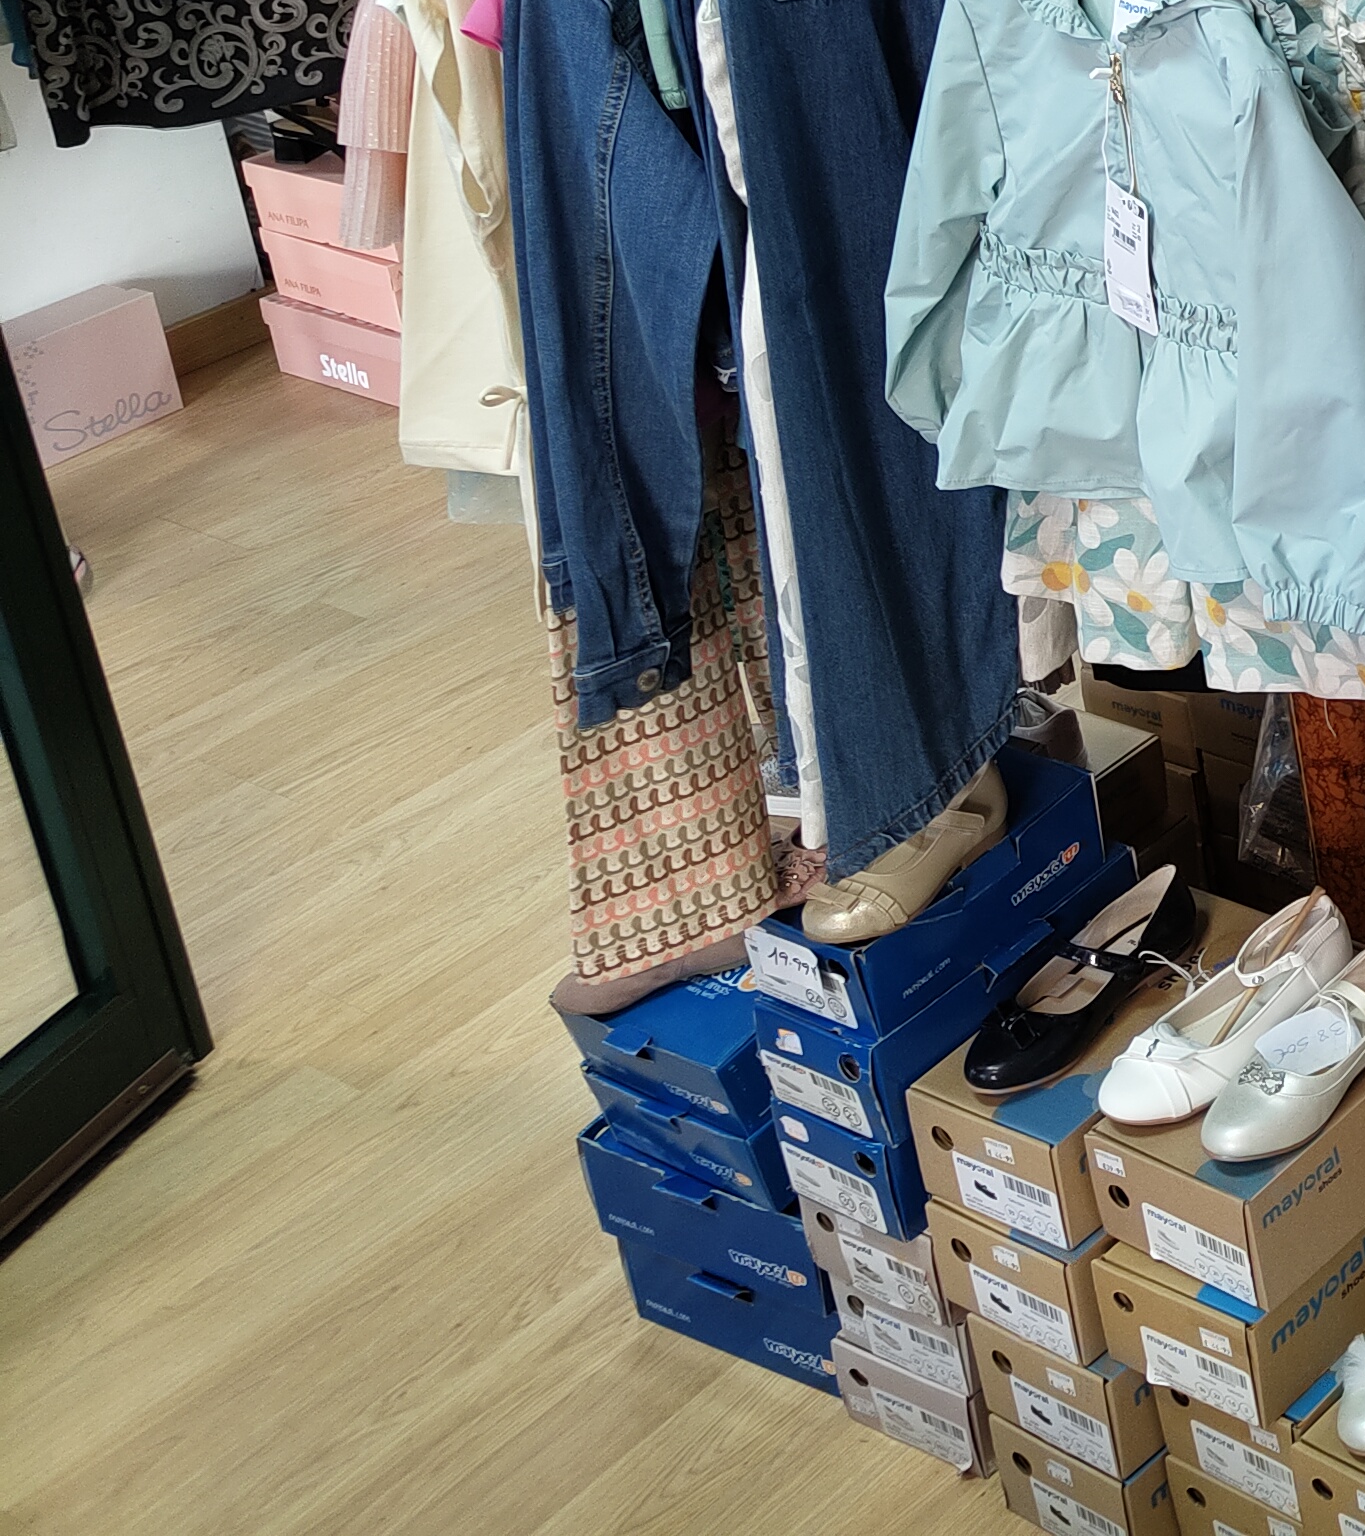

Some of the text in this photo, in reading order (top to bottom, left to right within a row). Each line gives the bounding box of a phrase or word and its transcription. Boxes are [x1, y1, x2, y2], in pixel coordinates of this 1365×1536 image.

[268, 211, 310, 230] ANA FILIPA
[284, 277, 322, 298] ANA FILIPA
[319, 353, 370, 390] Stella
[44, 388, 172, 452] Stella
[1111, 700, 1161, 722] mayoral
[1011, 852, 1064, 907] mayoral
[956, 1156, 995, 1178] mayoral
[1262, 1145, 1342, 1230] mayoral
[1317, 1167, 1343, 1194] shoes
[1147, 1208, 1187, 1234] mayoral
[973, 1268, 1009, 1292] mayoral
[865, 1309, 902, 1330] mayoral
[1146, 1333, 1188, 1358] mayoral
[876, 1392, 914, 1413] mayoral
[1013, 1381, 1050, 1405] mayoral
[1195, 1426, 1236, 1453] mayoral
[1033, 1481, 1068, 1506] mayoral
